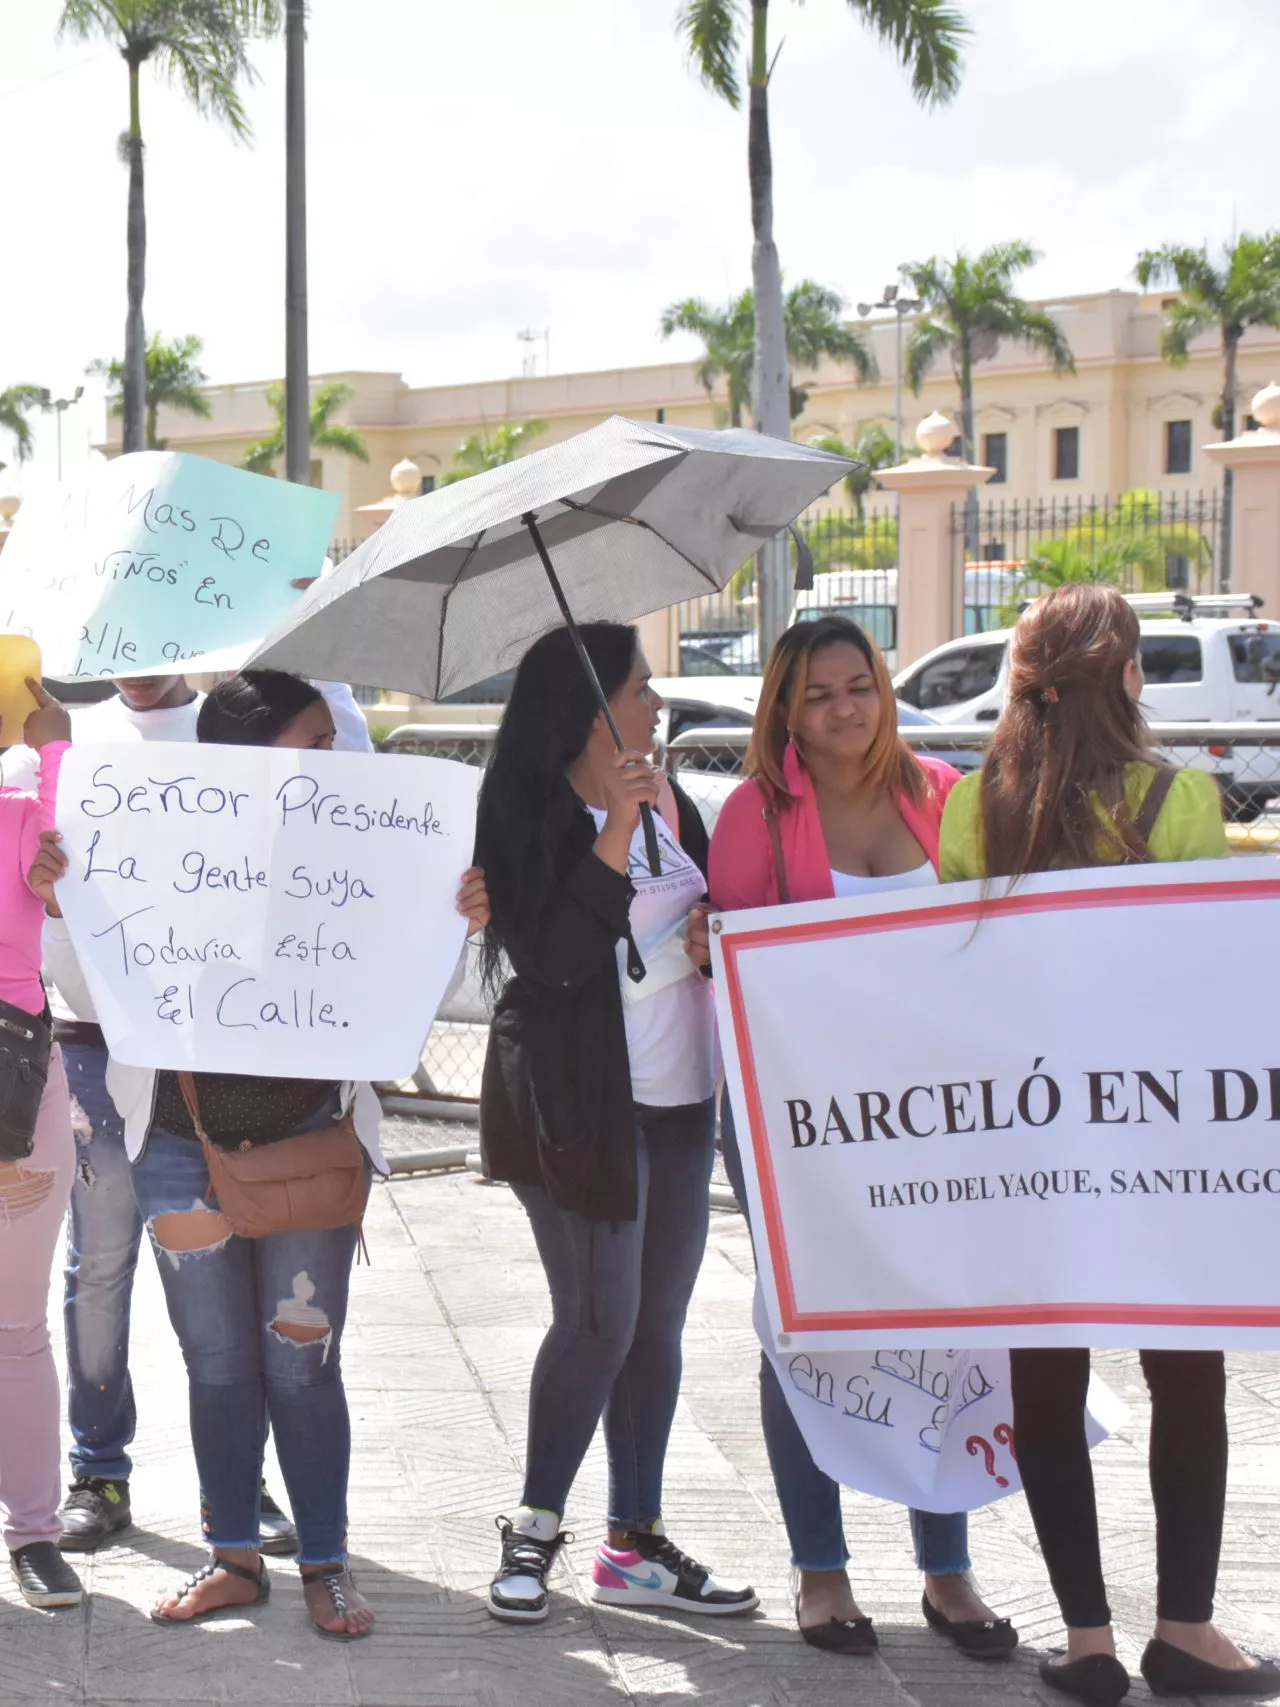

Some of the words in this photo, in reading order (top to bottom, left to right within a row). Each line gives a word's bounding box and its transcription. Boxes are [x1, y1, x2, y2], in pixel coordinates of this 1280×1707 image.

[210, 516, 270, 563] De
[195, 577, 234, 610] En
[80, 764, 250, 818] Señor
[83, 830, 148, 883] La
[274, 922, 357, 967] Esta
[154, 985, 195, 1025] El
[216, 978, 350, 1031] Calle.
[784, 1056, 1062, 1149] BARCELÓ
[1082, 1069, 1183, 1125] EN
[867, 1178, 939, 1208] HATO
[946, 1176, 995, 1203] DEL
[998, 1168, 1102, 1201] YAQUE,
[1110, 1168, 1280, 1196] SANTIAGO
